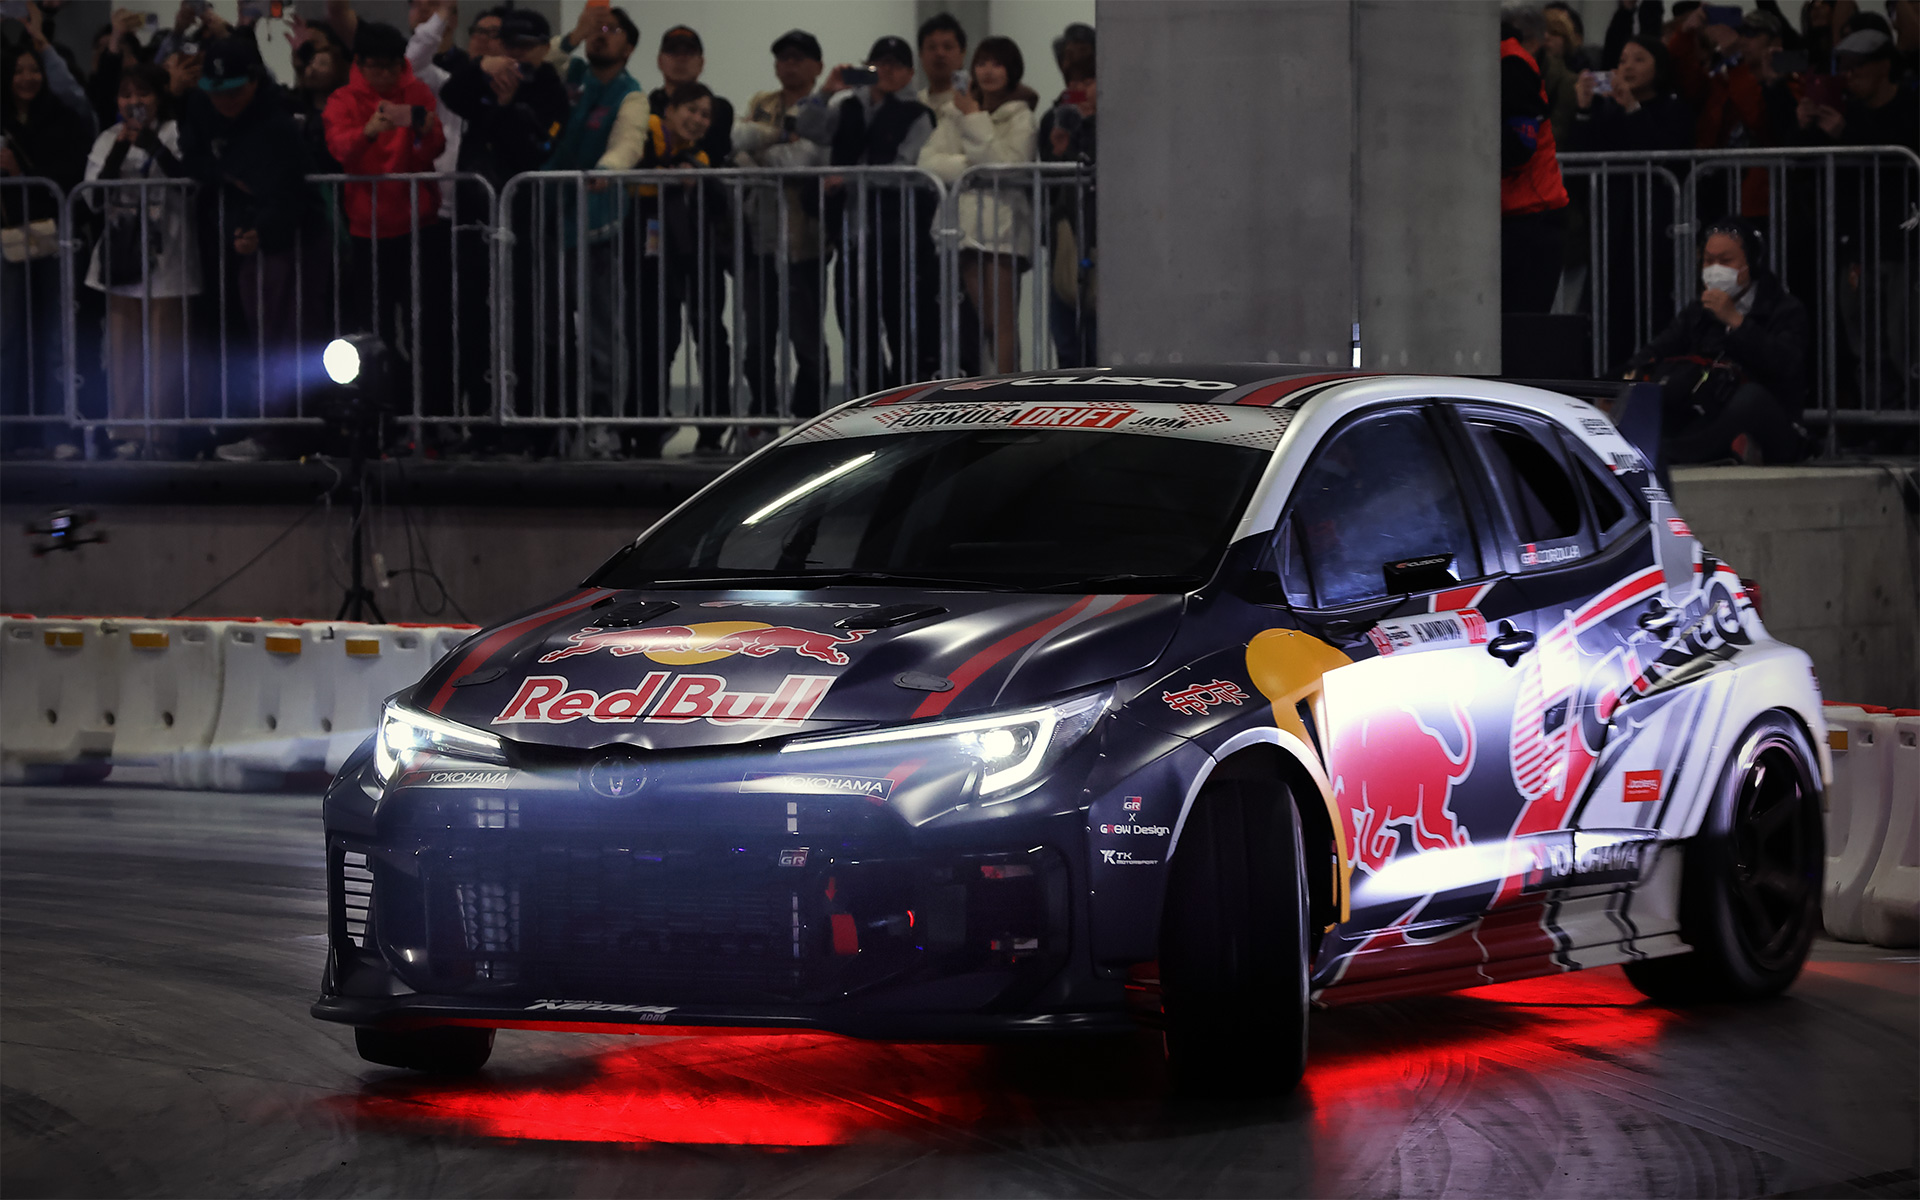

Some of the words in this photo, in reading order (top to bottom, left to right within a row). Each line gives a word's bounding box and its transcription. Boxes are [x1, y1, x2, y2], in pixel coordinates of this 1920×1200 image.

[888, 409, 1022, 427] FORMULA
[1018, 408, 1130, 426] DRIFT
[1128, 416, 1193, 429] JAPAN
[490, 671, 672, 724] Red
[643, 674, 838, 727] Bull
[427, 772, 509, 784] YOKOHAMA
[783, 776, 883, 793] YOKOHAMA
[1124, 801, 1140, 810] GR
[1133, 825, 1170, 836] Design
[781, 856, 805, 865] GR
[1116, 852, 1132, 860] TK
